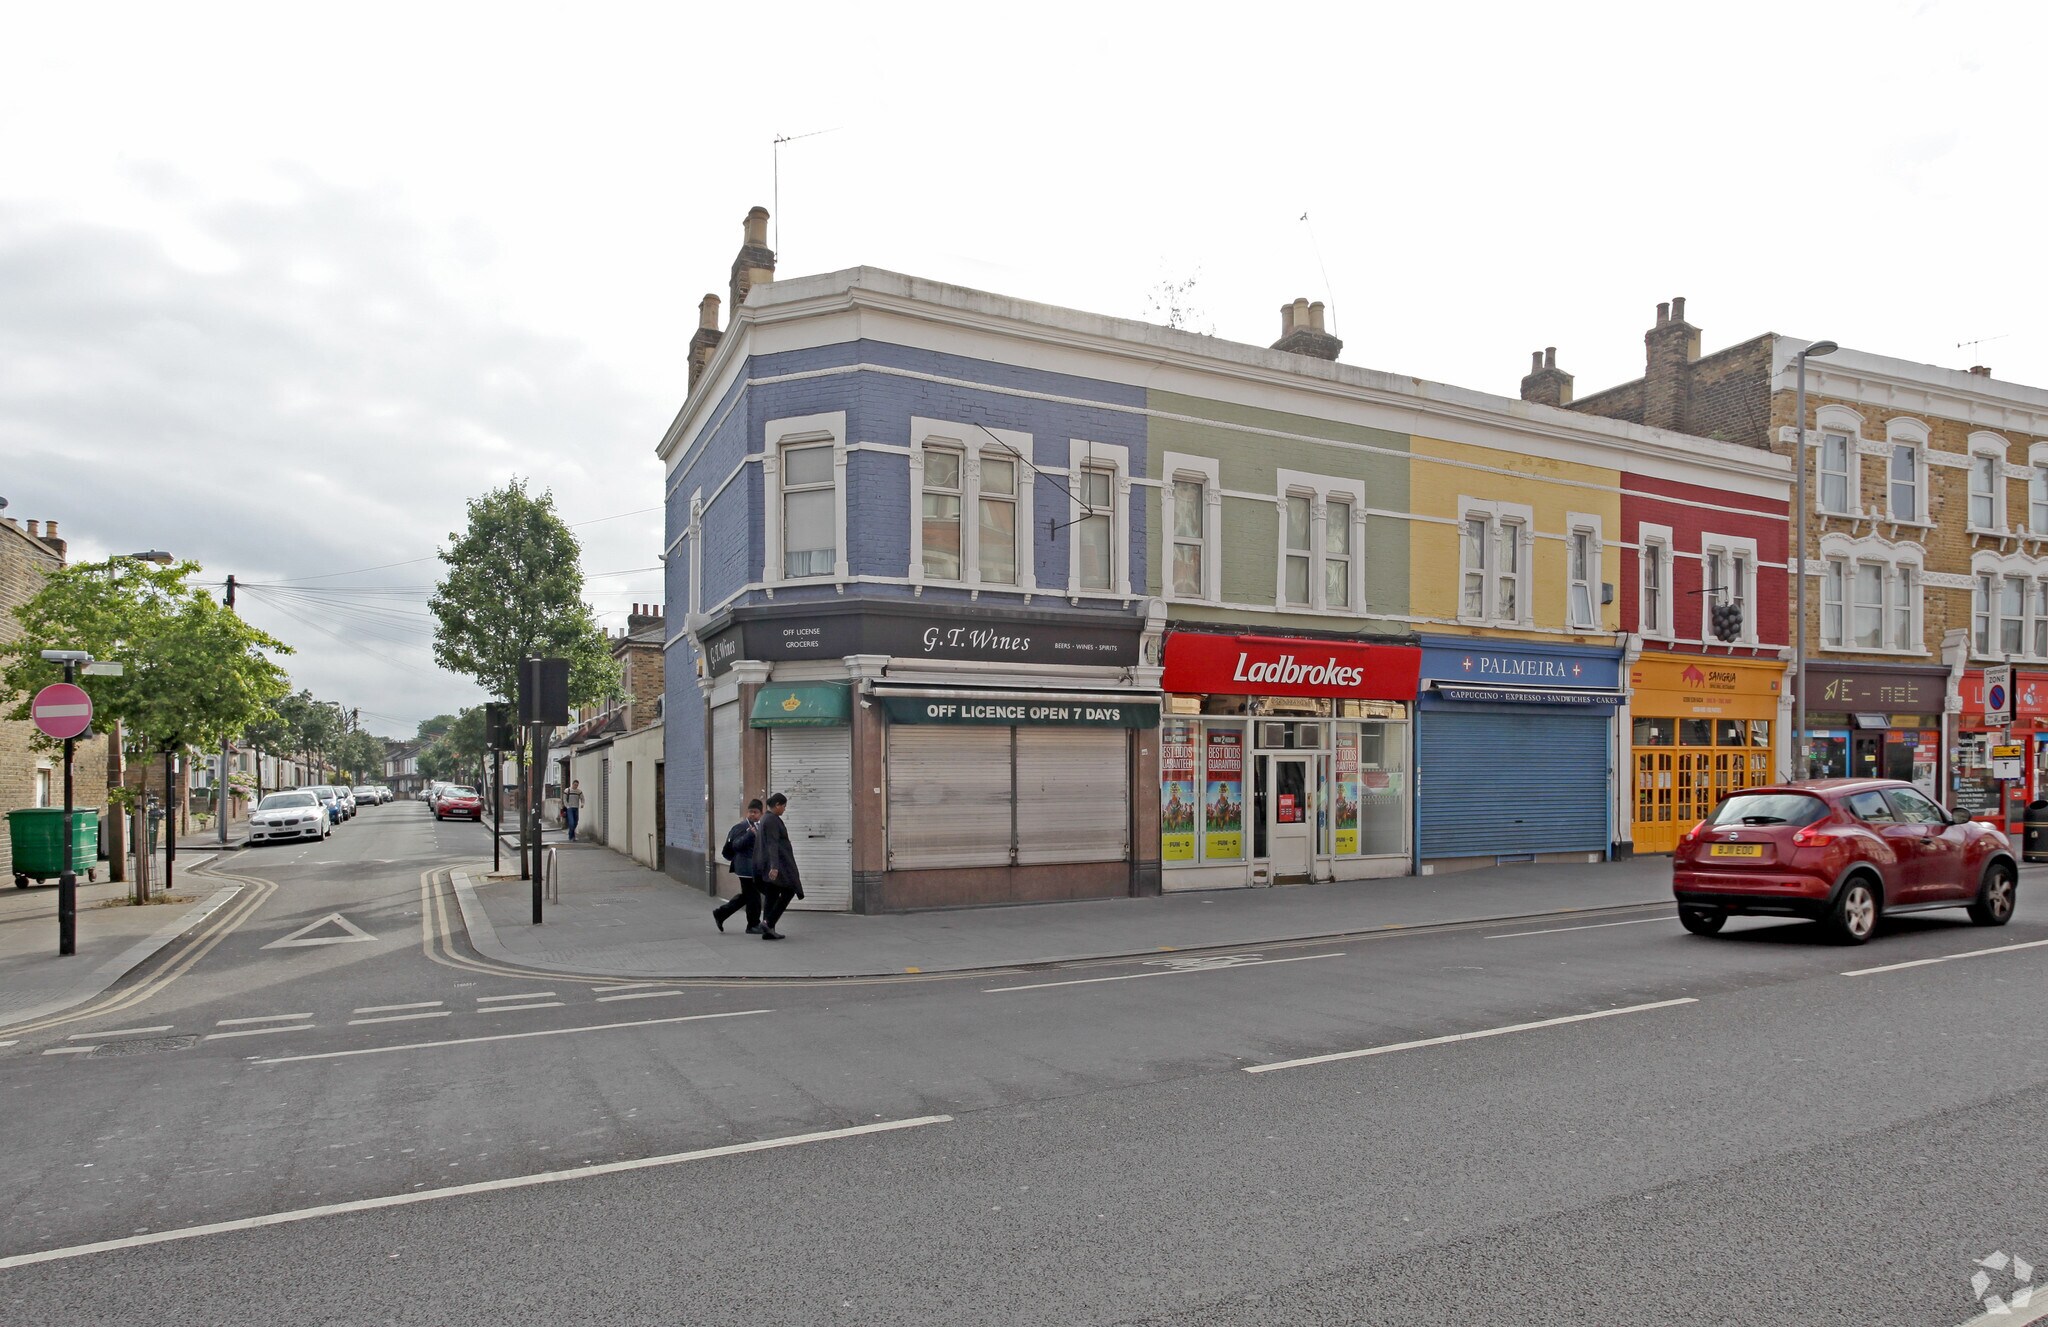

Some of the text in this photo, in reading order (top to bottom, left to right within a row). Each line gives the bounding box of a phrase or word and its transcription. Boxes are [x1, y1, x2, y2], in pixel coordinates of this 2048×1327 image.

[796, 628, 820, 636] LICENSE
[785, 640, 819, 648] GROCERIES
[1054, 642, 1118, 652] BEERS WINES SPIRITS
[1233, 652, 1364, 686] Ladbrokes
[1480, 657, 1566, 677] PALMEIRA
[1708, 671, 1736, 683] SANGRIA
[1988, 675, 2005, 684] ZONE
[1450, 690, 1618, 704] CAPPUCCINO EXPRESSO SANDWICHES CAKES
[927, 704, 1121, 721] OFF LICENCE OPEN 7 DAYS
[1162, 746, 1193, 758] EST ODDS
[1208, 747, 1241, 759] BEST ODDS
[1341, 750, 1357, 761] ODDS
[1162, 758, 1193, 769] UARANTEED
[1208, 759, 1241, 770] GUARANTEED
[2003, 762, 2009, 770] T
